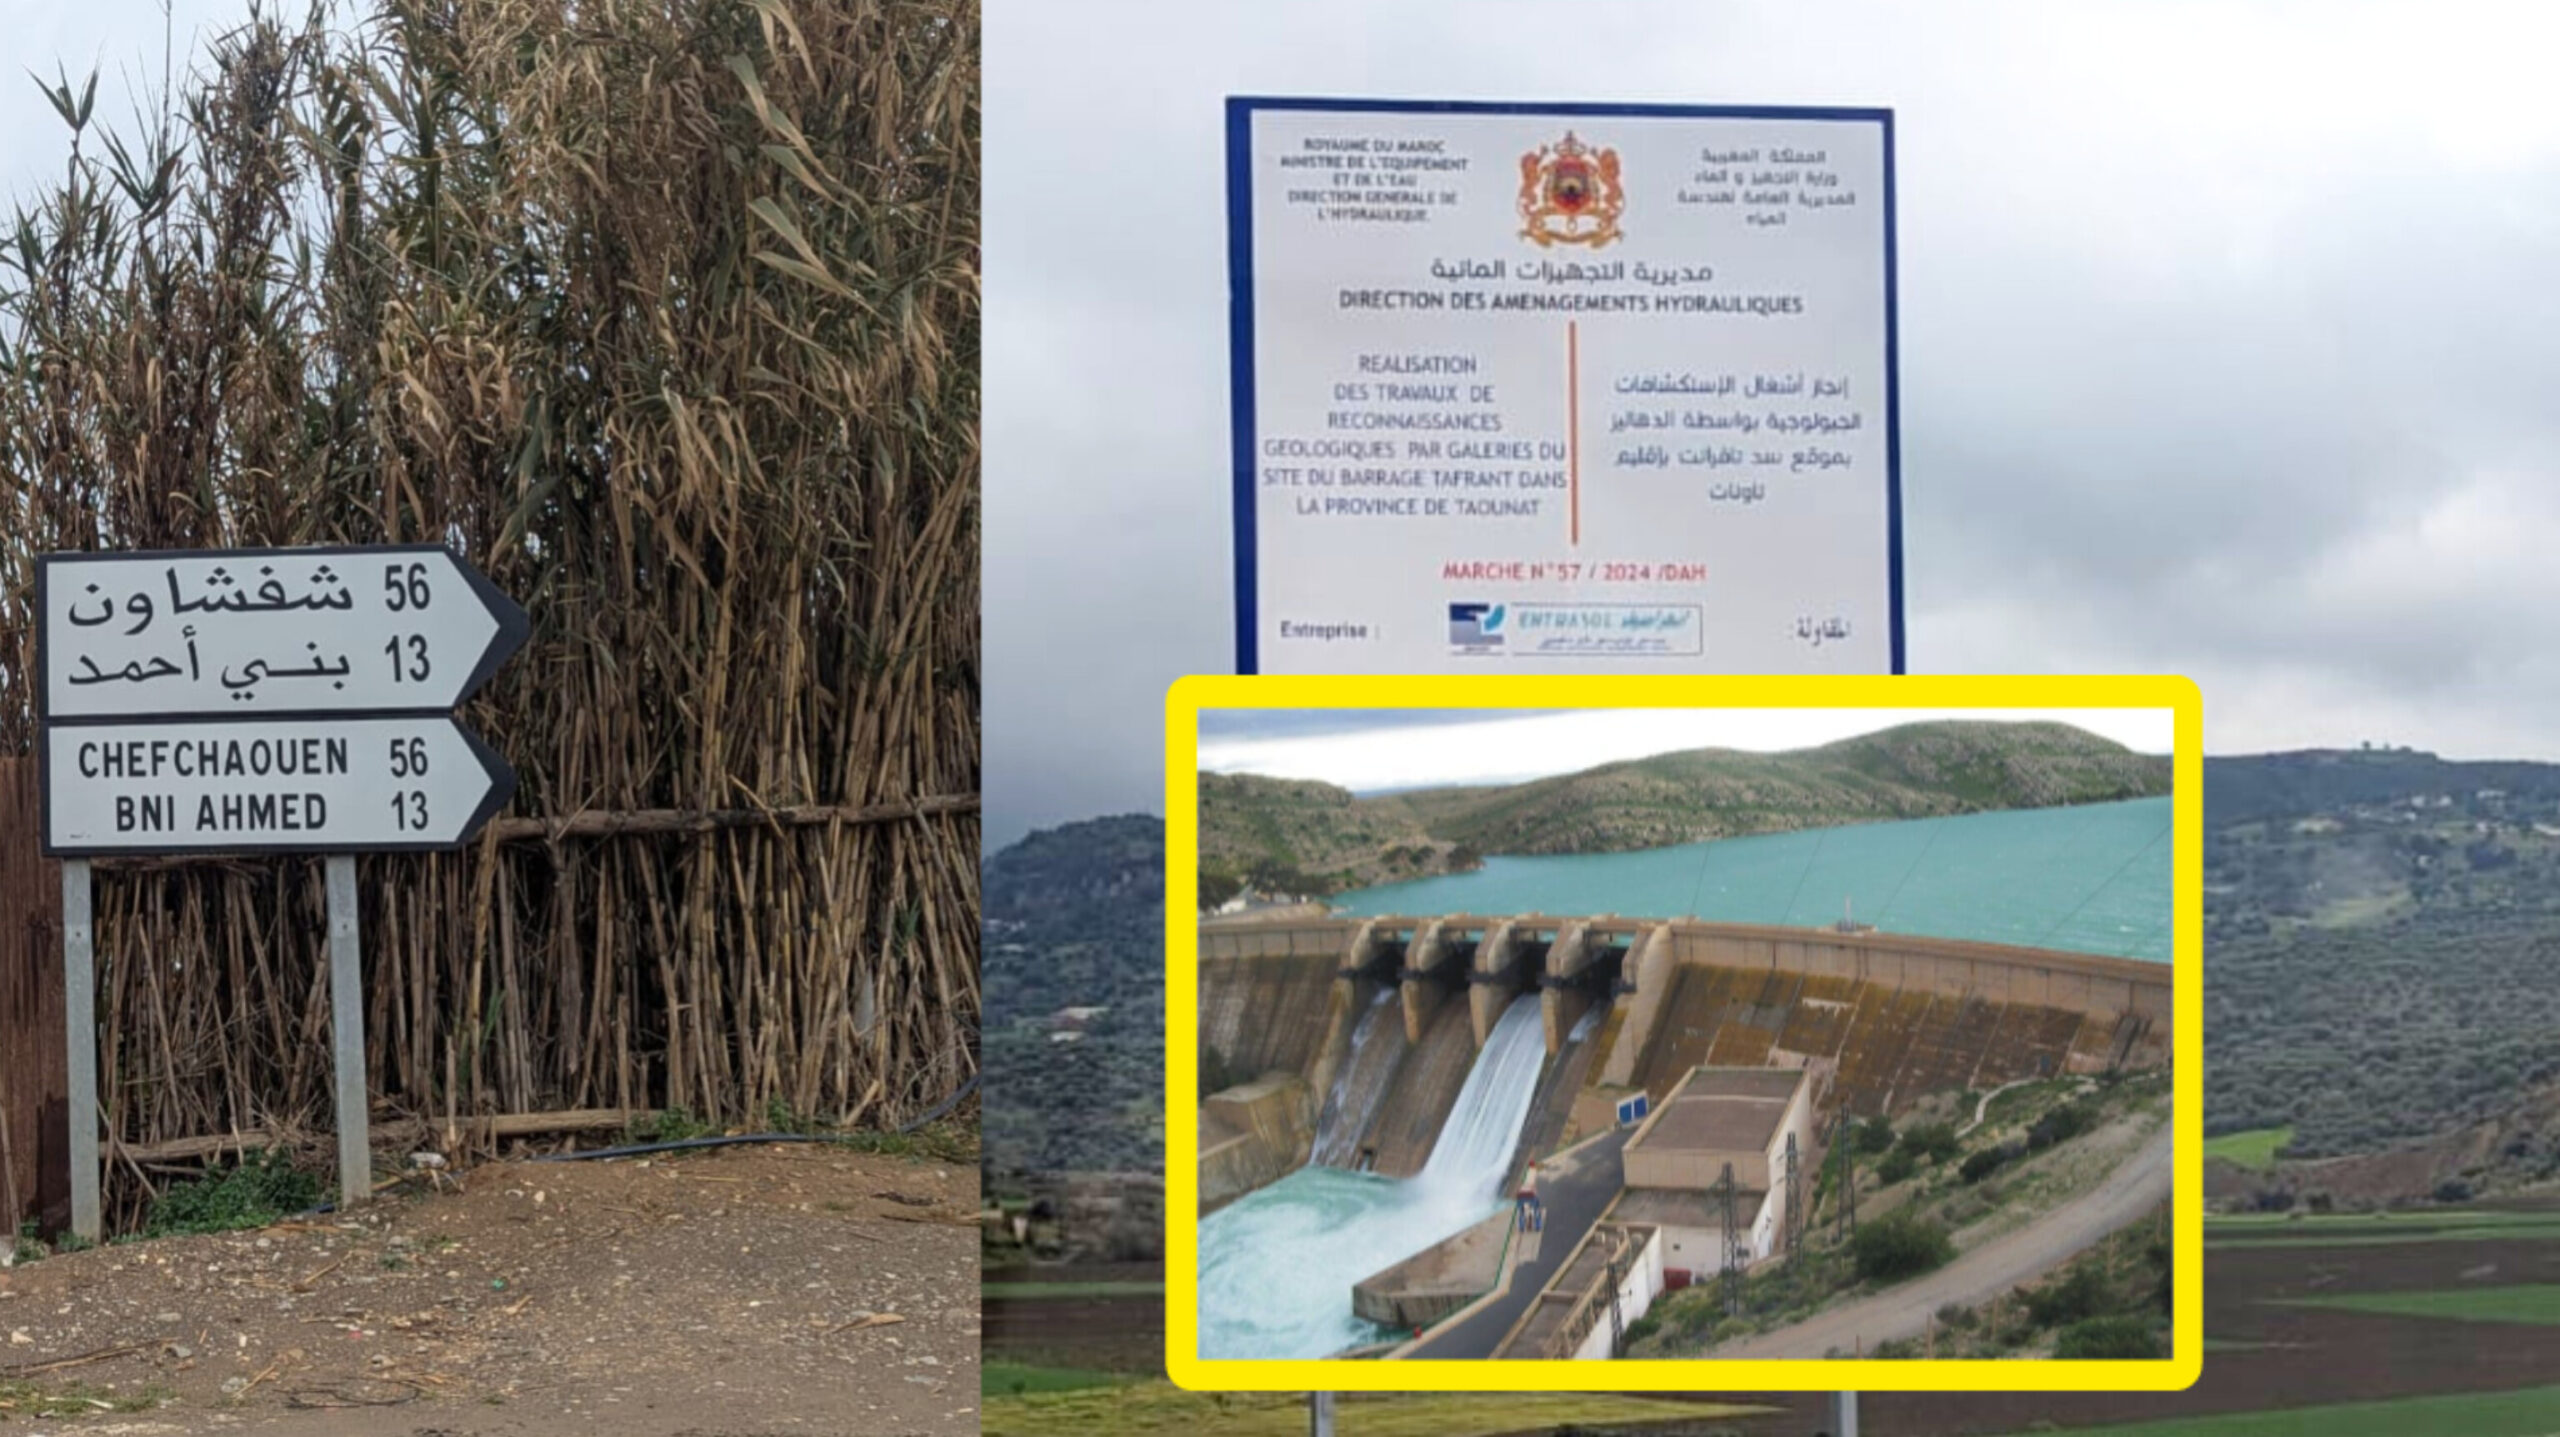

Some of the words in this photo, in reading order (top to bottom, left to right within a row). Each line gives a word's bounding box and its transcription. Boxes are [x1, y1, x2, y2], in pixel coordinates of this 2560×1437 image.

[1303, 138, 1370, 152] ROYAUME
[1374, 139, 1393, 152] DU
[1397, 140, 1446, 154] MAROC
[1347, 156, 1365, 169] DE
[1333, 173, 1351, 186] ET
[1355, 173, 1371, 187] DE
[1376, 173, 1418, 187] L'EAU
[1288, 190, 1362, 204] DIRECTION
[1365, 190, 1436, 205] GENERALE
[1440, 192, 1458, 205] DE
[1516, 259, 1625, 285] التجهيزات
[1632, 261, 1714, 287] مديرية
[1339, 289, 1445, 309] DIRECTION
[1450, 291, 1487, 310] DES
[1490, 291, 1650, 313] AMENAGEMENTS
[1655, 294, 1805, 316] HYDRAULIQUES
[1358, 354, 1478, 375] REALISATION
[1334, 383, 1370, 402] DES
[1375, 384, 1458, 403] TRAVAUX
[1470, 385, 1495, 404] DE
[1327, 411, 1502, 432] RECONNAISSANCES
[1263, 438, 1396, 461] GEOLOGIQUES
[1408, 440, 1442, 459] PAR
[1448, 441, 1532, 461] GALERIES
[1539, 442, 1567, 461] DU
[1789, 448, 1853, 473] بموقع
[1262, 467, 1303, 486] SITE
[1307, 468, 1335, 486] DU
[1341, 468, 1423, 488] BARRAGE
[1431, 469, 1514, 489] TAFRANT
[1518, 470, 1568, 489] DANS
[1296, 496, 1321, 516] LA
[1325, 497, 1418, 516] PROVINCE
[1424, 497, 1450, 516] DE
[1455, 498, 1543, 517] TAOUNAT
[1442, 562, 1525, 581] MARCHE
[1603, 564, 1650, 582] 2024
[68, 564, 353, 636] شفشاون
[383, 561, 432, 613] 56
[1280, 619, 1368, 641] Entreprise
[68, 625, 202, 686] أحمد
[384, 633, 432, 684] 13
[220, 640, 351, 702] بني
[78, 737, 349, 779] CHEFCHAOUEN
[389, 736, 429, 779] 56
[115, 795, 176, 833] BNI
[195, 793, 328, 833] AHMED
[390, 790, 429, 833] 13
